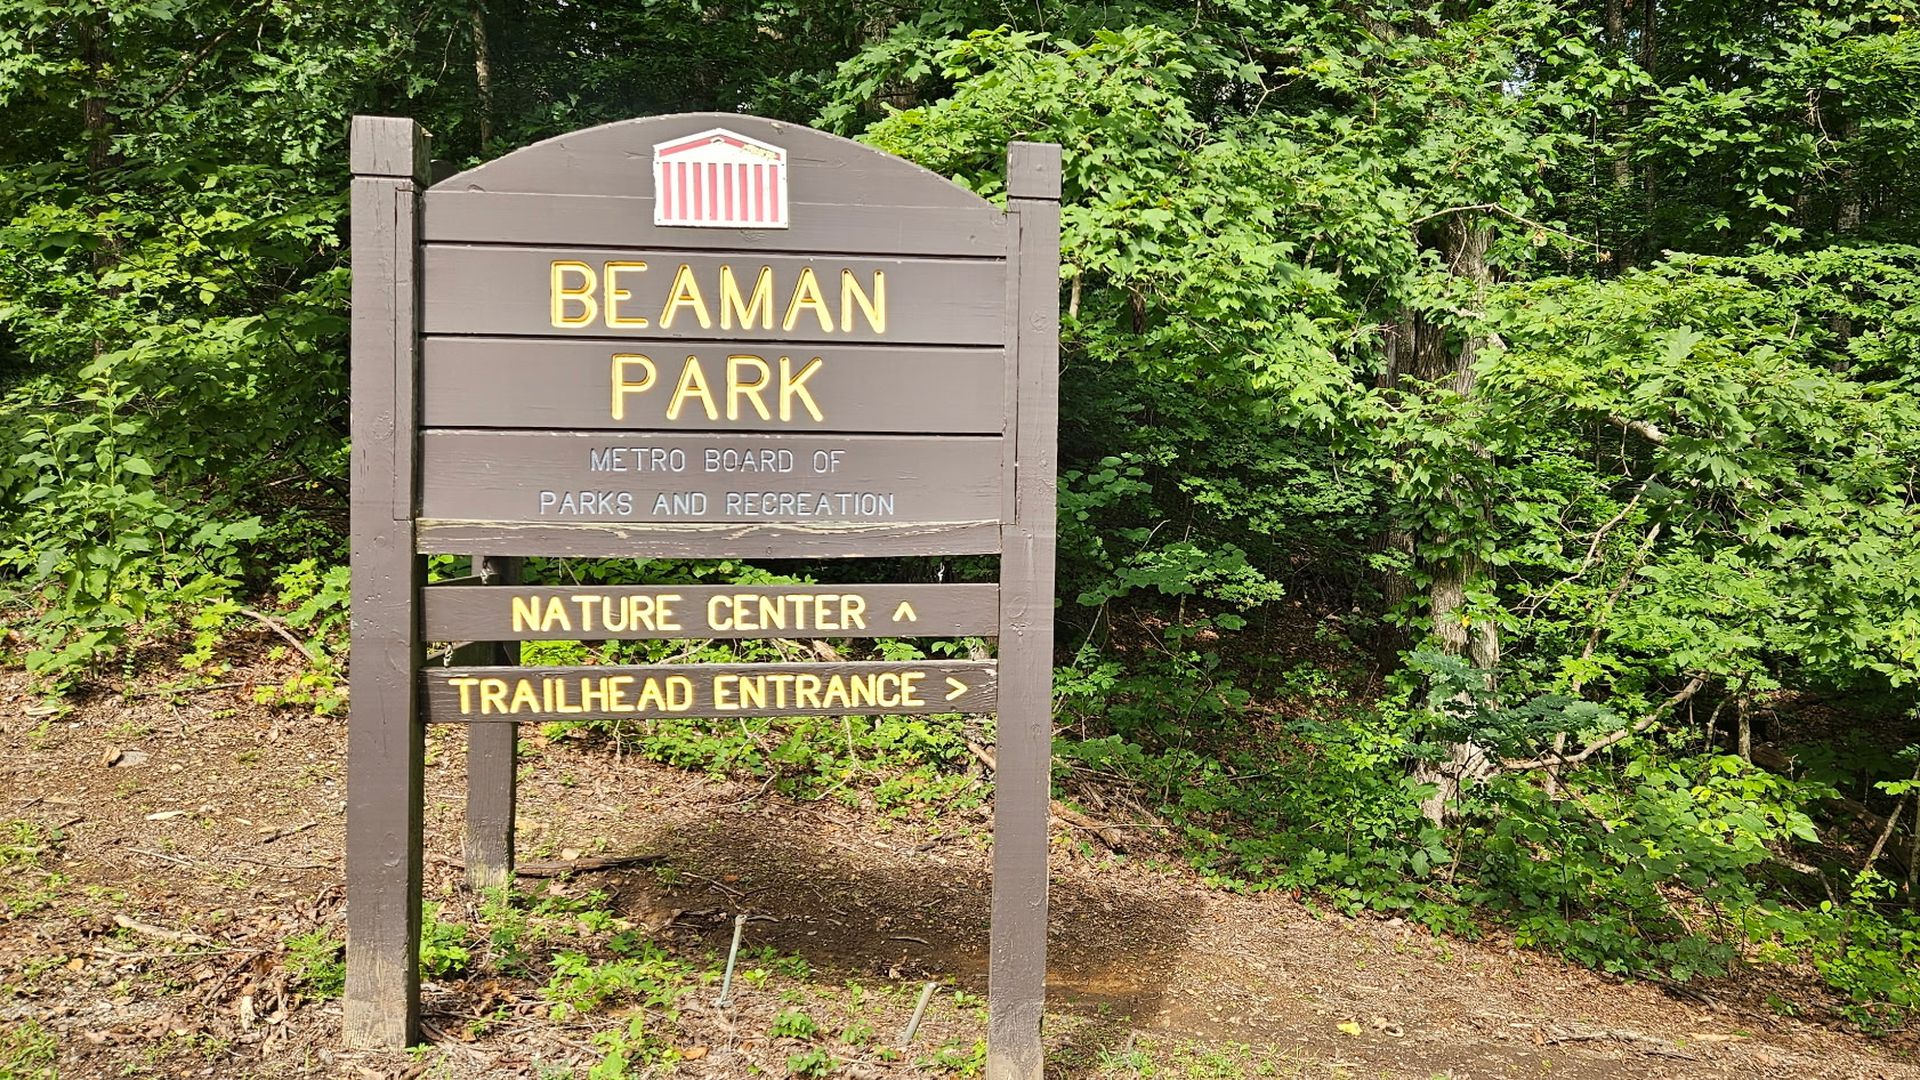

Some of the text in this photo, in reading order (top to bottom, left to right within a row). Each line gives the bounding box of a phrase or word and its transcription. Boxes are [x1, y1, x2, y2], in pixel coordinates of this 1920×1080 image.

[549, 259, 886, 334] BEAMAN
[610, 352, 824, 423] PARK
[590, 447, 846, 474] METRO BOARD OF
[539, 490, 895, 517] PARKS AND RECREATION
[511, 593, 867, 633] NATURE CENTER
[448, 671, 926, 716] TRAILHEAD ENTRANCE
